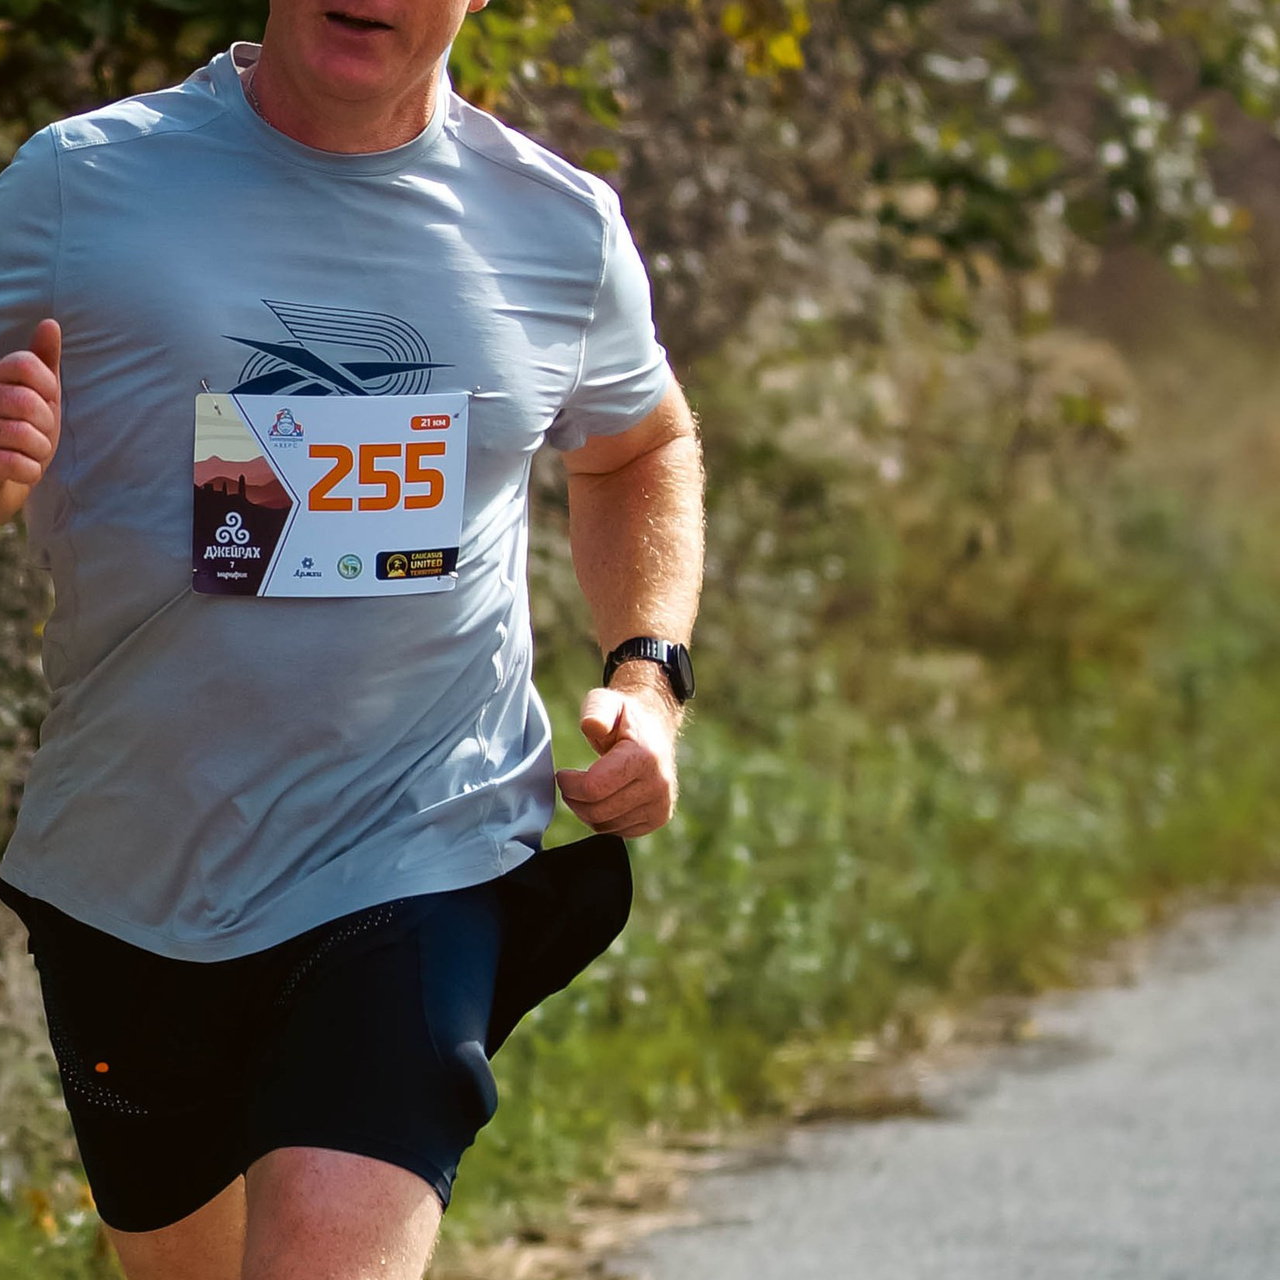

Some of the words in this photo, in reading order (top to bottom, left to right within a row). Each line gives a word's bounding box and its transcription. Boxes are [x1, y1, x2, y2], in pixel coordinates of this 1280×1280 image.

[420, 418, 431, 427] 21
[308, 442, 446, 511] 255
[203, 545, 261, 559] ДЖЕЙРАХ
[411, 551, 443, 560] CAUCASUS
[229, 561, 235, 569] 7
[410, 559, 443, 569] UNITED
